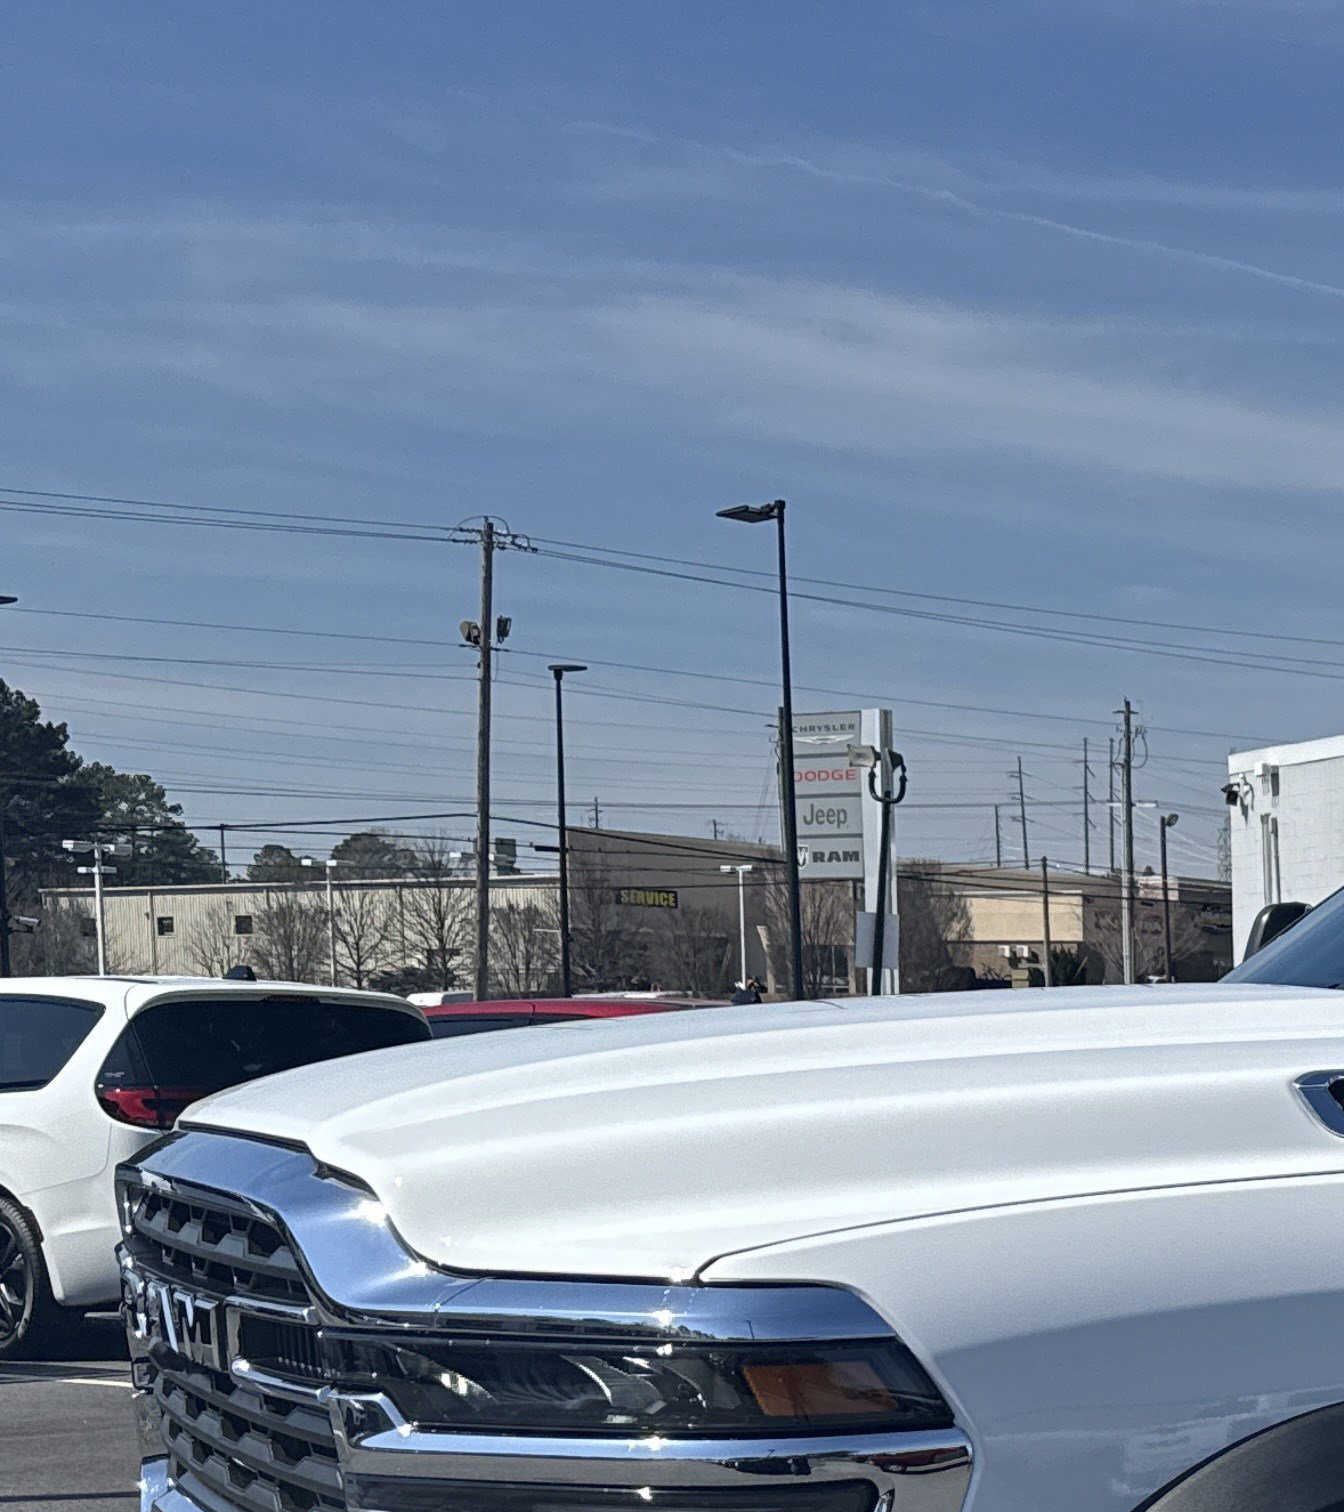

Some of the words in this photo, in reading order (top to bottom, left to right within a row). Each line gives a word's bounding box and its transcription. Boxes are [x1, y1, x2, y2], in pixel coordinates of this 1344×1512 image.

[792, 723, 856, 734] CHRYSLER
[795, 769, 856, 783] DODGE
[803, 804, 847, 829] Jeep
[812, 851, 860, 863] RAM
[620, 889, 676, 907] SERVICE
